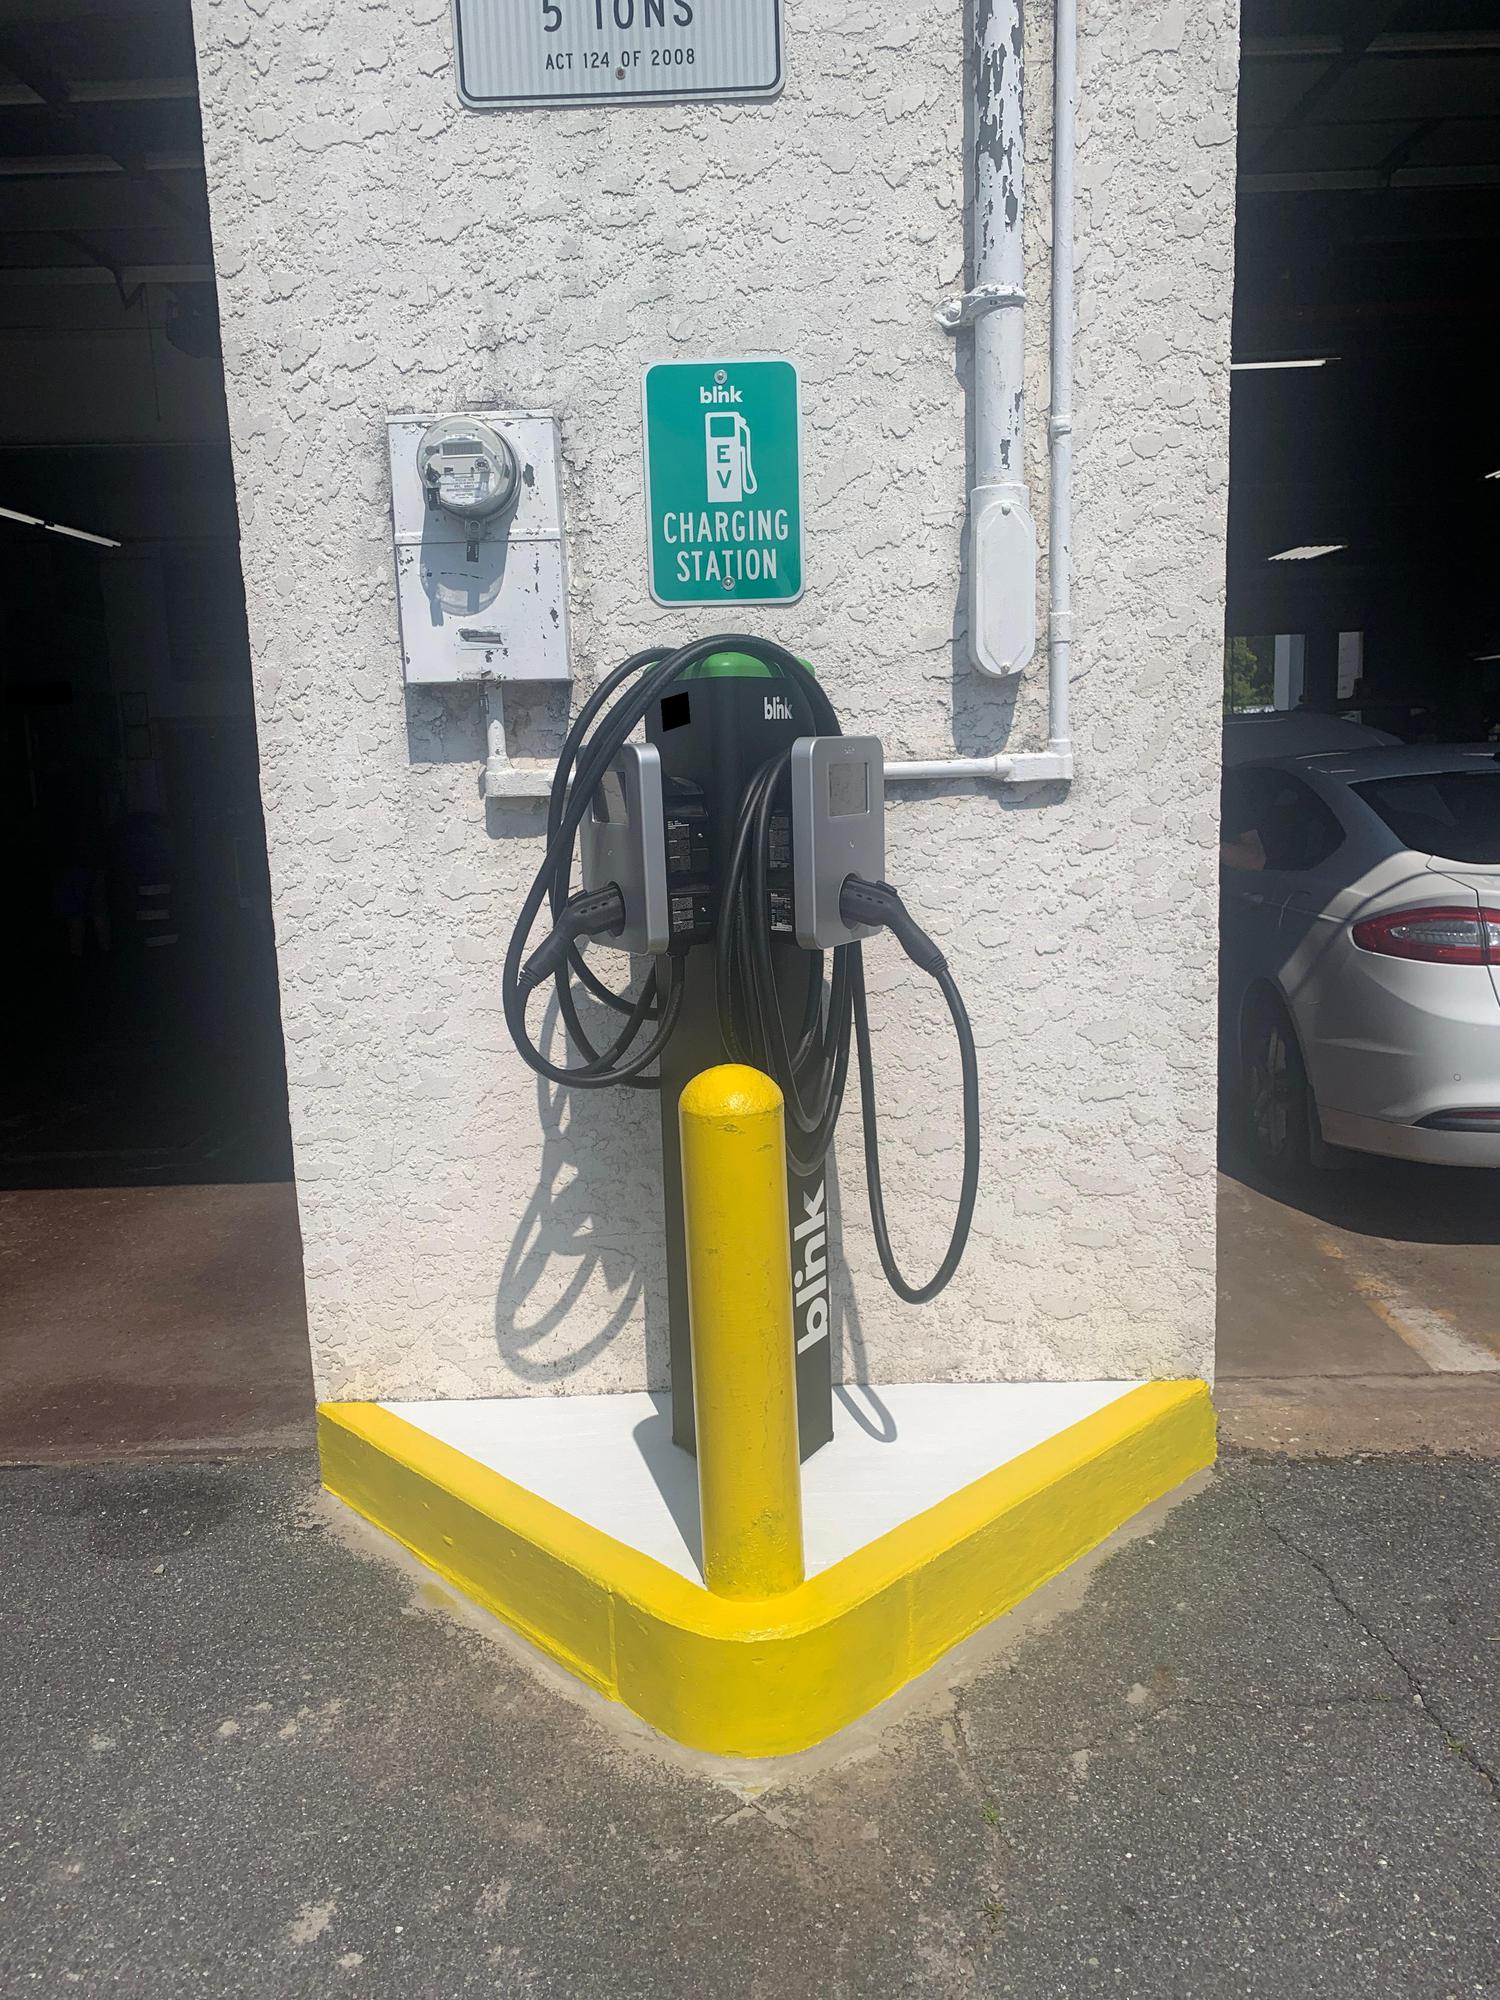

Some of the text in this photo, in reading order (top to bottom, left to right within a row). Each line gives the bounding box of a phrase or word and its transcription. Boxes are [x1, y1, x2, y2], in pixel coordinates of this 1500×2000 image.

[542, 0, 563, 32] 5
[545, 48, 695, 70] ACT 124 OF 2008
[699, 385, 744, 404] blink
[663, 508, 789, 544] CHARGING
[676, 548, 778, 582] STATION
[763, 696, 793, 720] blink
[793, 1179, 829, 1356] blink
